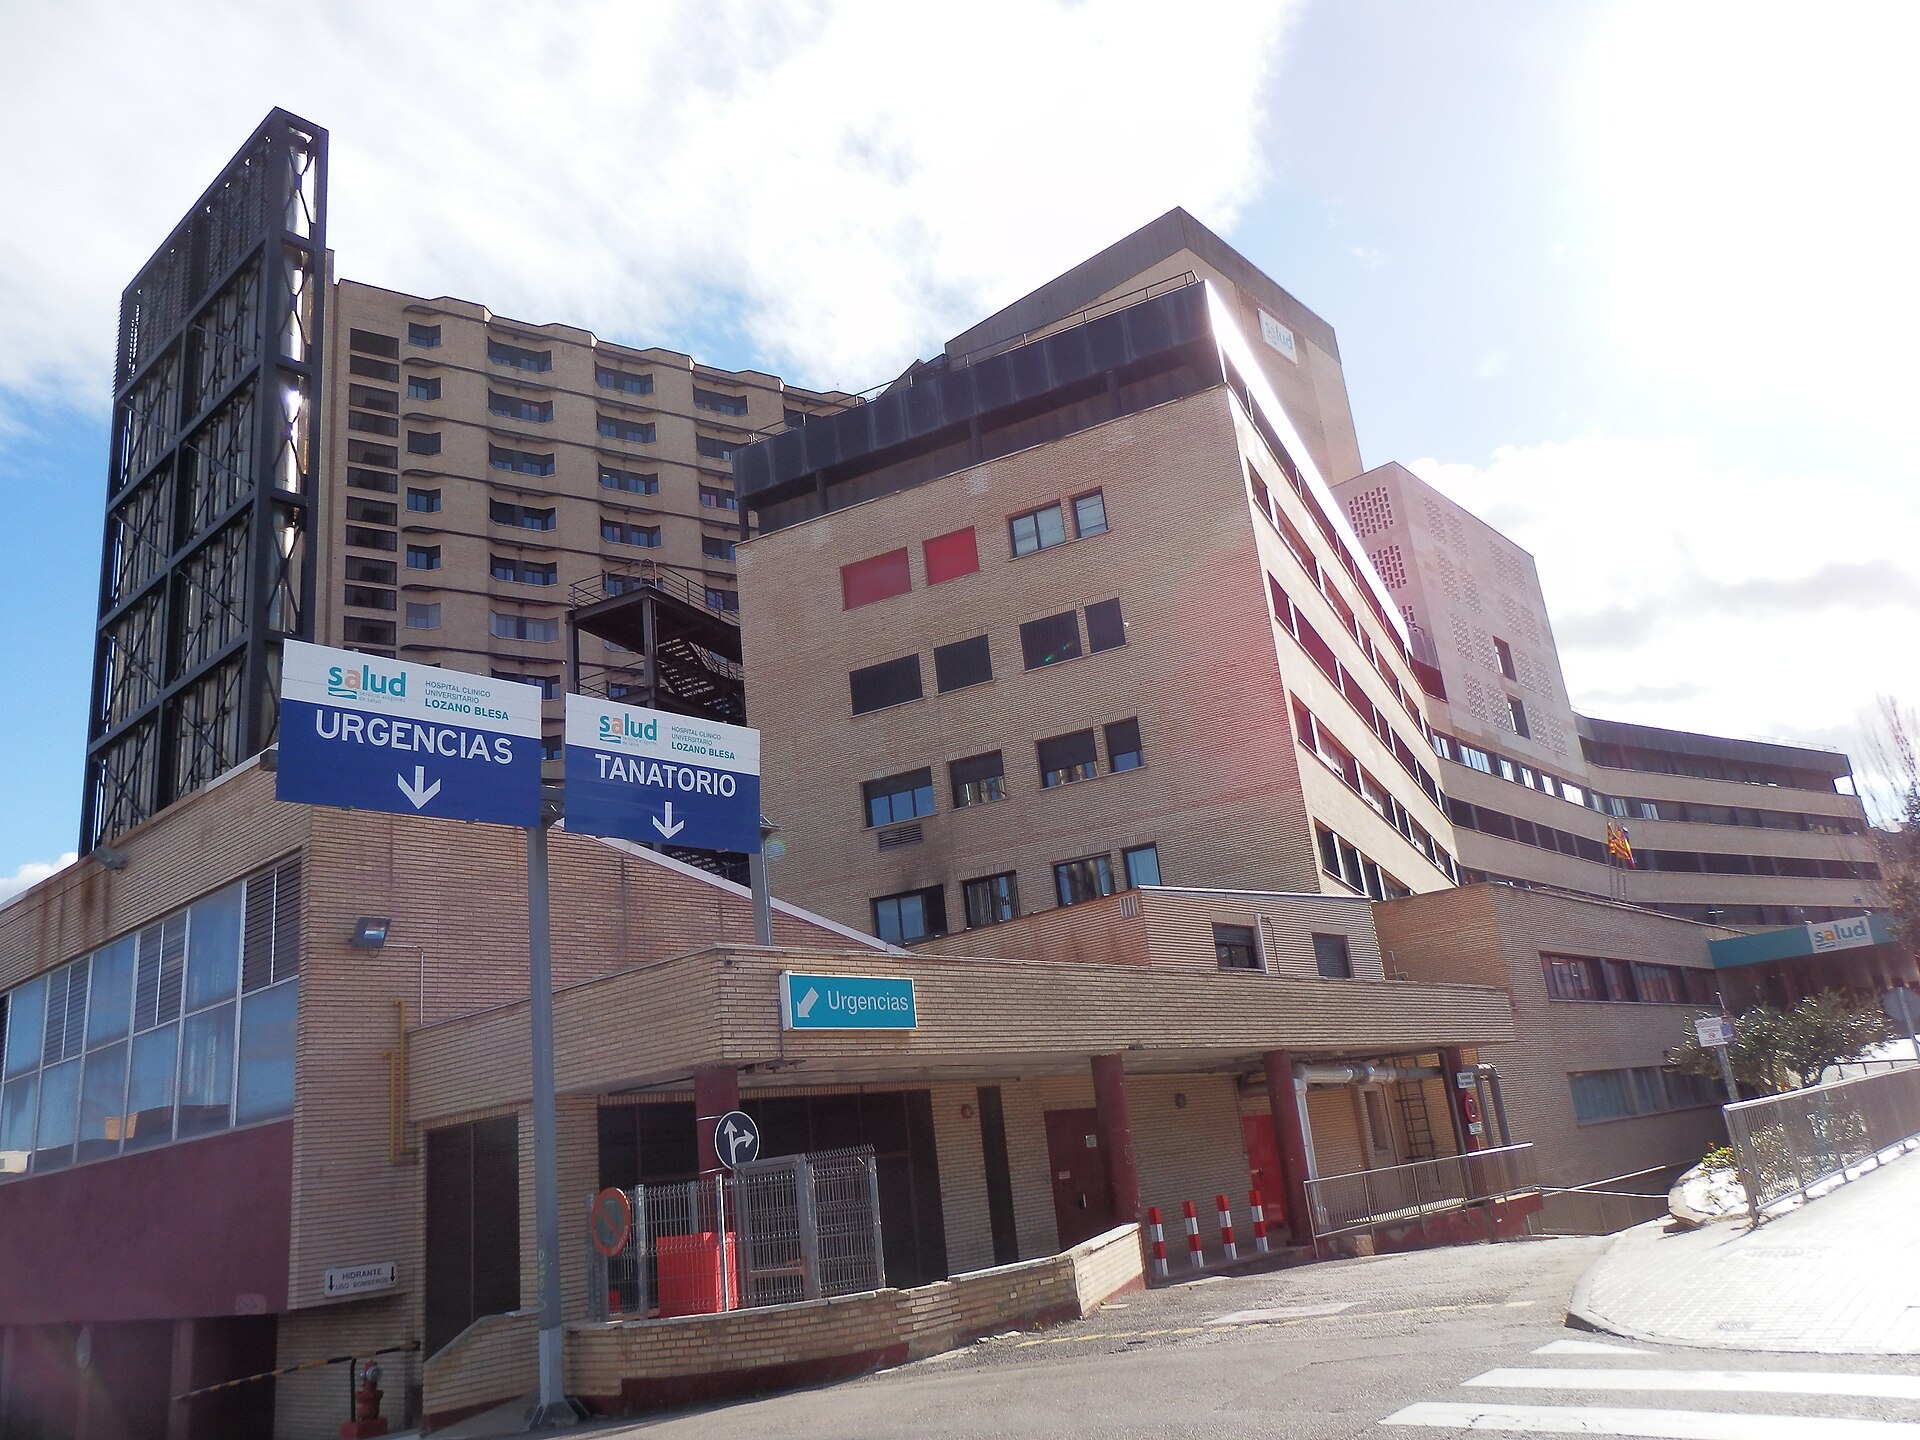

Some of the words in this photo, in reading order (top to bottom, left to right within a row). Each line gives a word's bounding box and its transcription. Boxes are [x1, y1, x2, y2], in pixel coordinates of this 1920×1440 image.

[328, 664, 407, 698] salud
[425, 680, 461, 693] HOSPITAL
[462, 686, 491, 698] CLINICO
[425, 688, 480, 704] UNIVERSITARIO
[425, 698, 471, 714] LOZANO
[474, 706, 509, 721] BLESA
[316, 709, 513, 765] URGENCIAS
[599, 713, 657, 741] salud
[671, 726, 698, 737] HOSPITAL
[699, 731, 722, 741] CLINICO
[671, 733, 713, 746] UNIVERSITARIO
[671, 741, 707, 755] LOZANO
[708, 748, 736, 760] BLESA
[595, 753, 736, 798] TANATORIO
[1813, 920, 1867, 943] salud
[827, 990, 909, 1015] Urgencias
[342, 1268, 382, 1280] HIDRANTE
